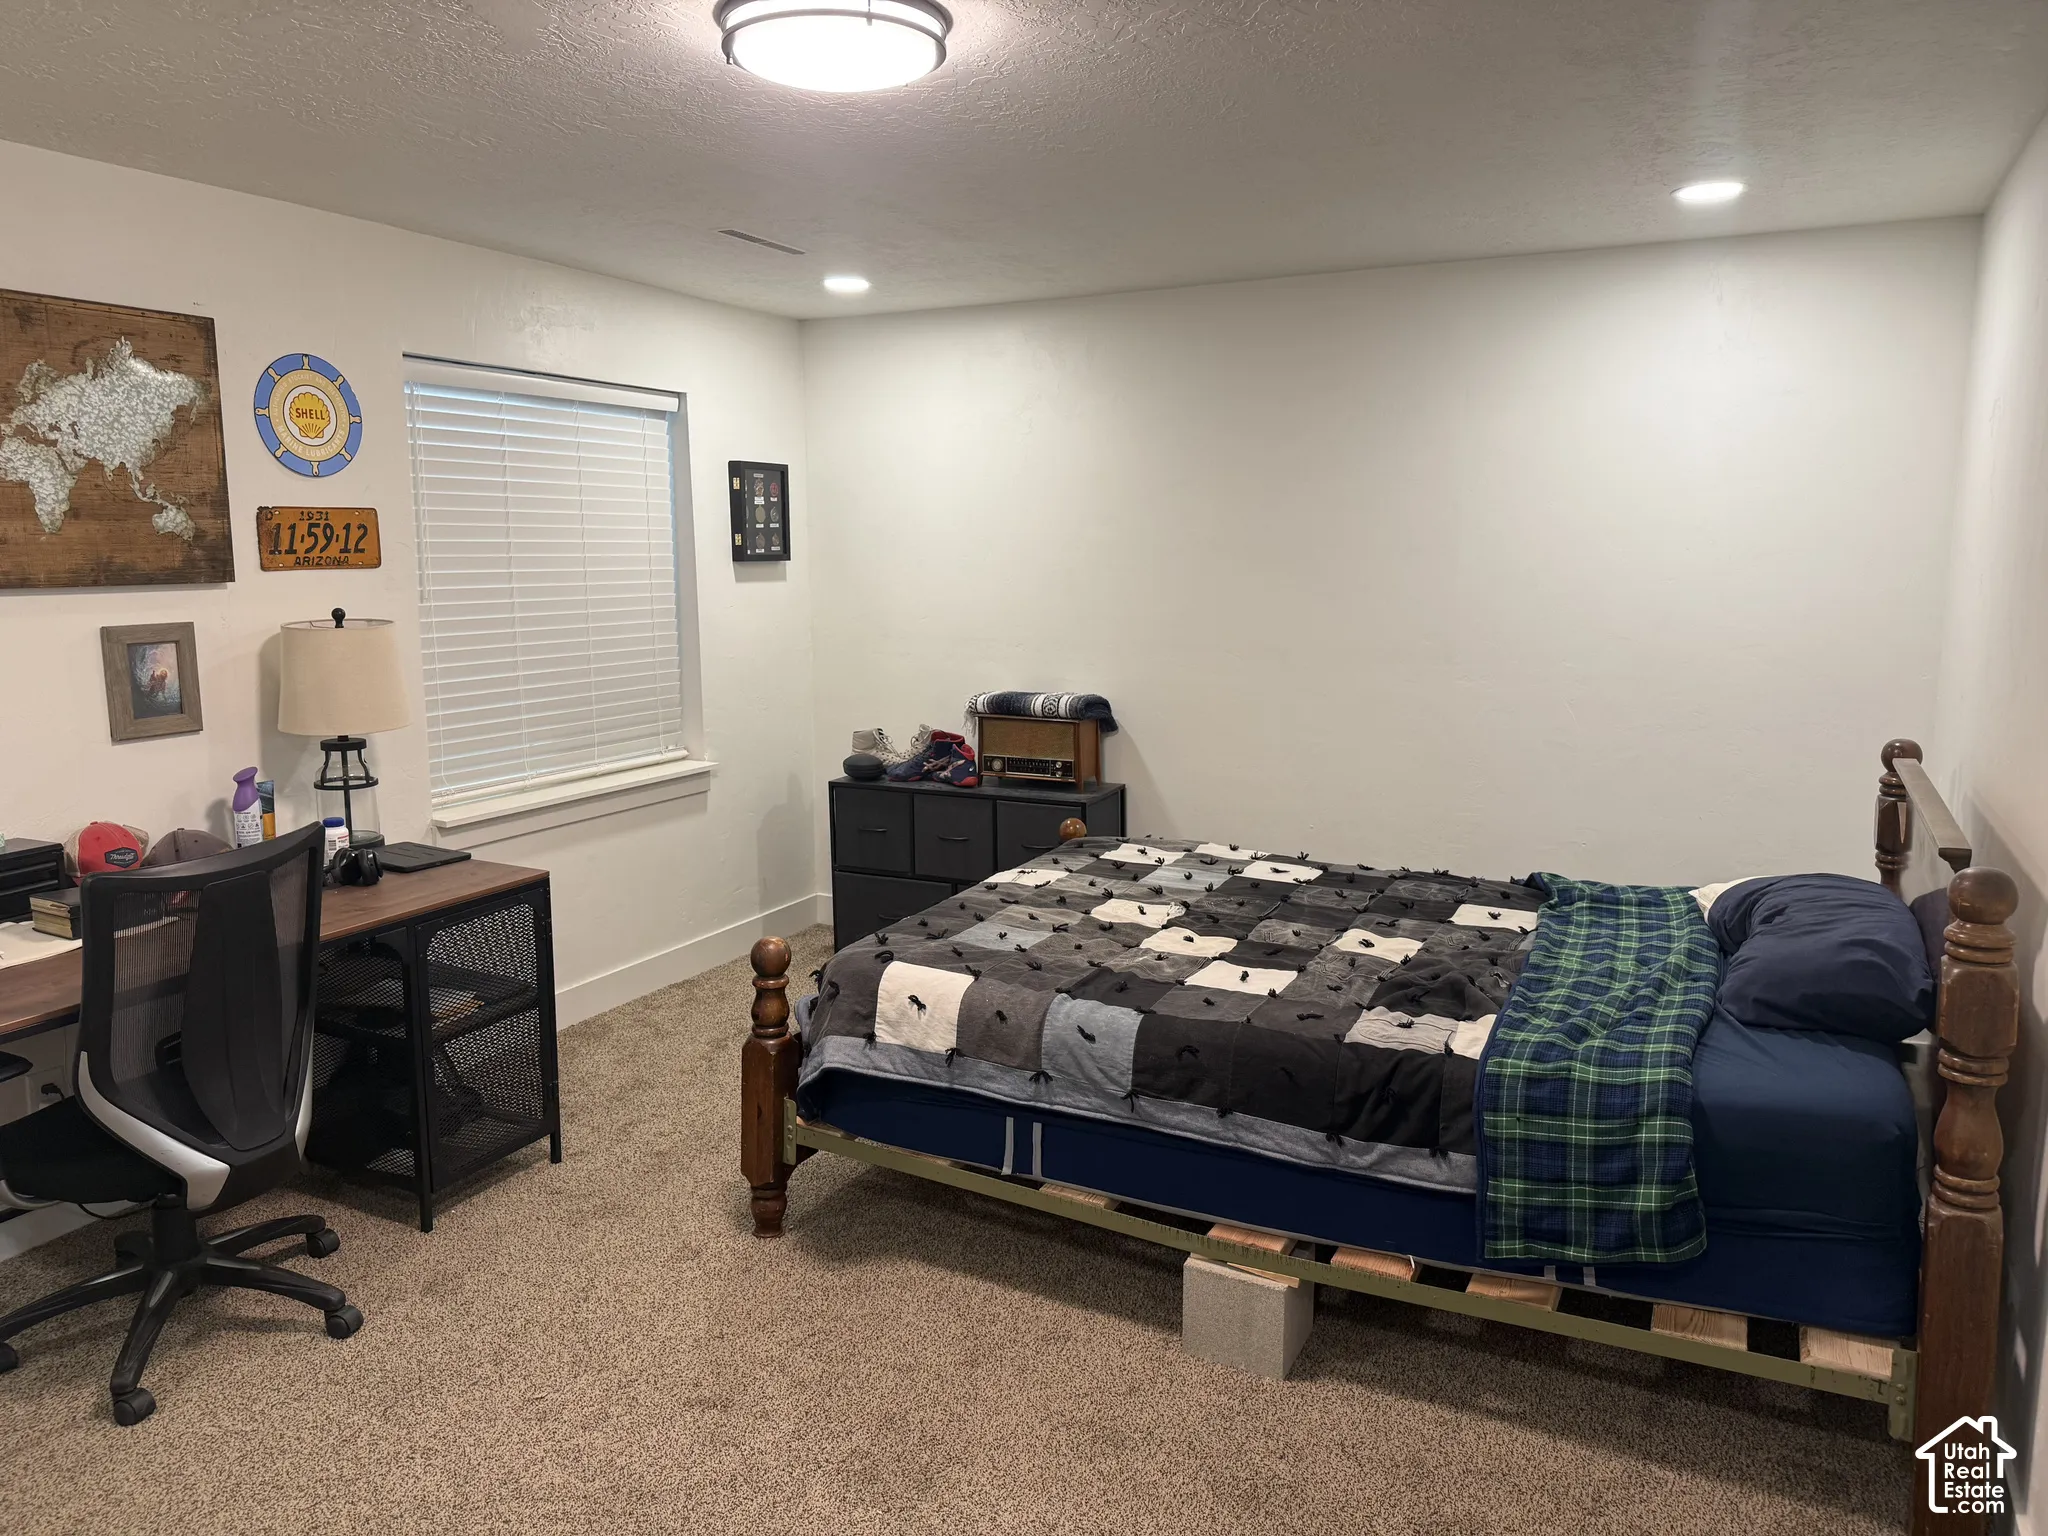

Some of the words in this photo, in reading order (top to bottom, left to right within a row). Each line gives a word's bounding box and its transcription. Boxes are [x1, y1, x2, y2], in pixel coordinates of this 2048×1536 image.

[295, 407, 326, 421] SHELL
[278, 425, 305, 453] MARINE
[305, 430, 346, 456] LUBRICANTS
[299, 510, 330, 521] 1931
[294, 555, 350, 566] ARIZONA
